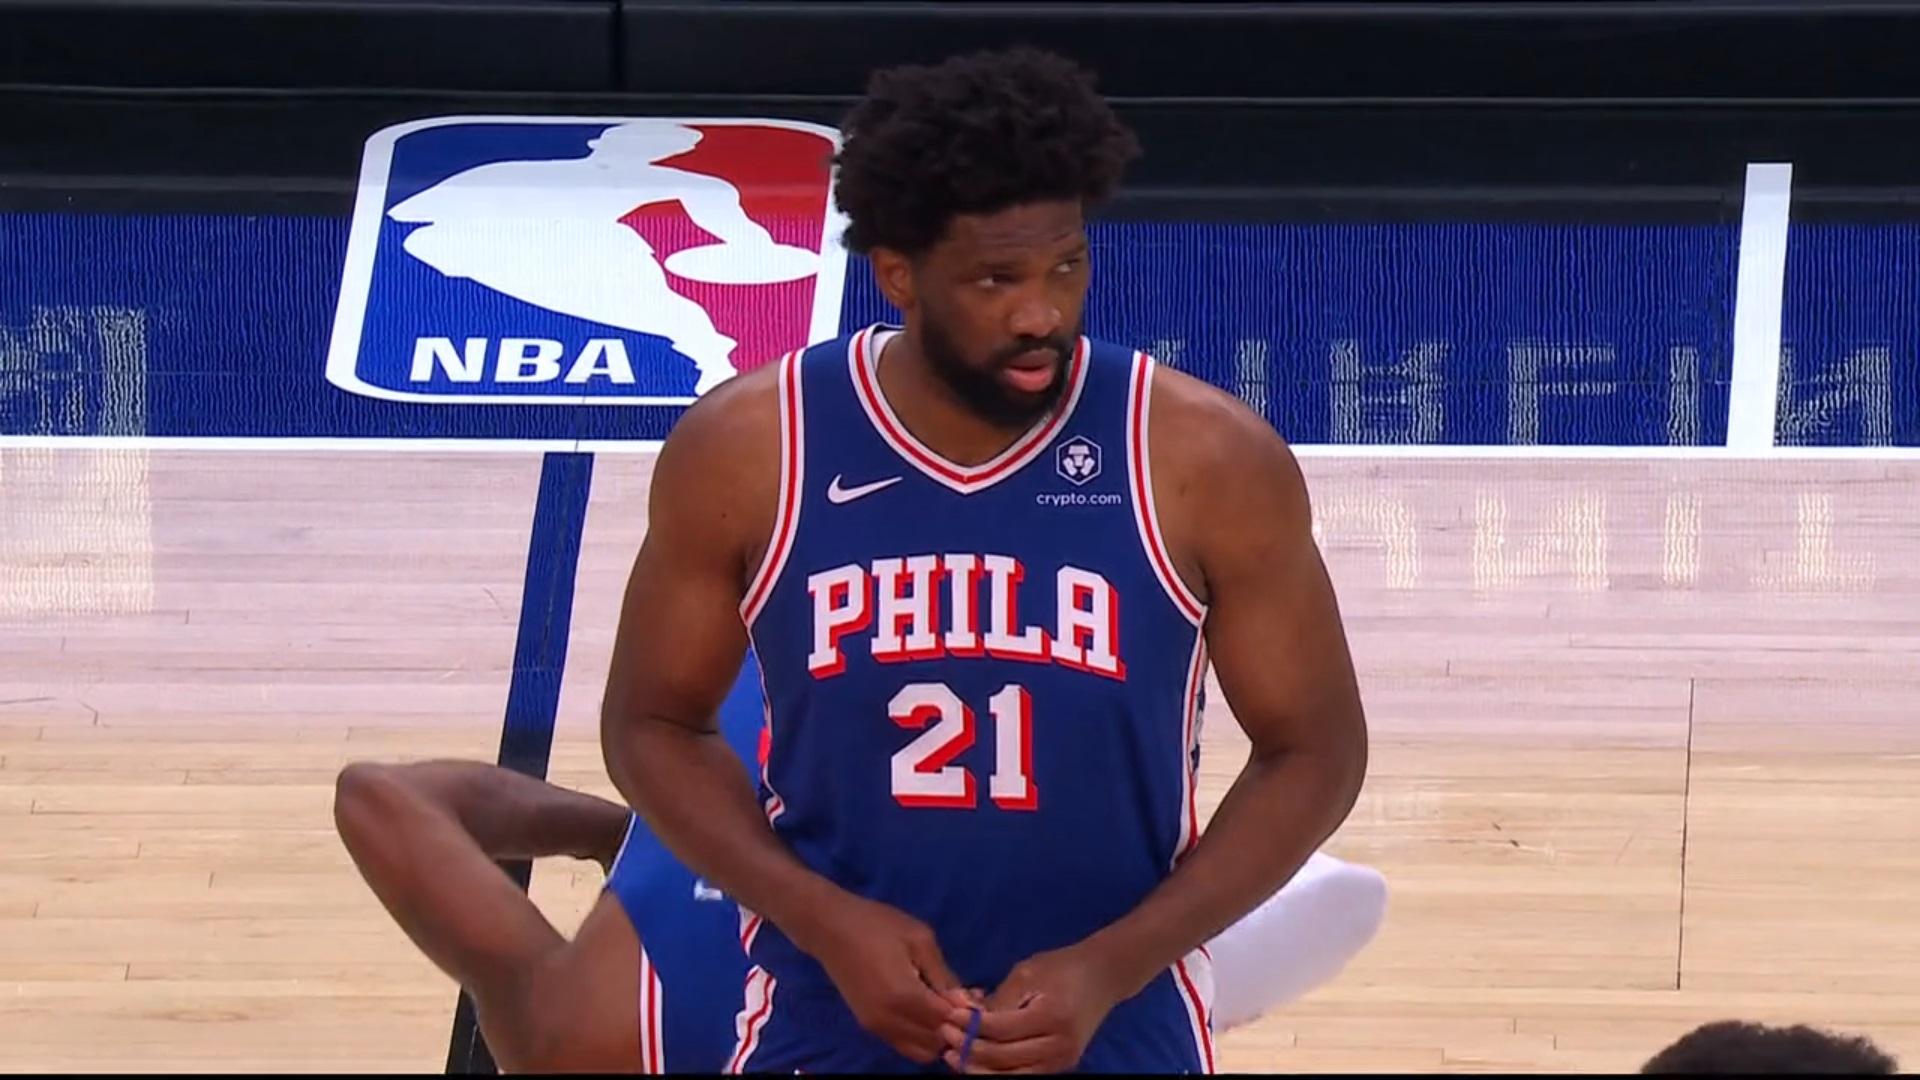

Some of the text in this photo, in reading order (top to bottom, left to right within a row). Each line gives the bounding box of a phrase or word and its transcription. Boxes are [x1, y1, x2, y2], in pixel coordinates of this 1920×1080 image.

[410, 337, 636, 384] NBA
[1036, 493, 1121, 506] crypto.com
[808, 554, 1126, 681] PHILA
[888, 683, 1038, 810] 21
